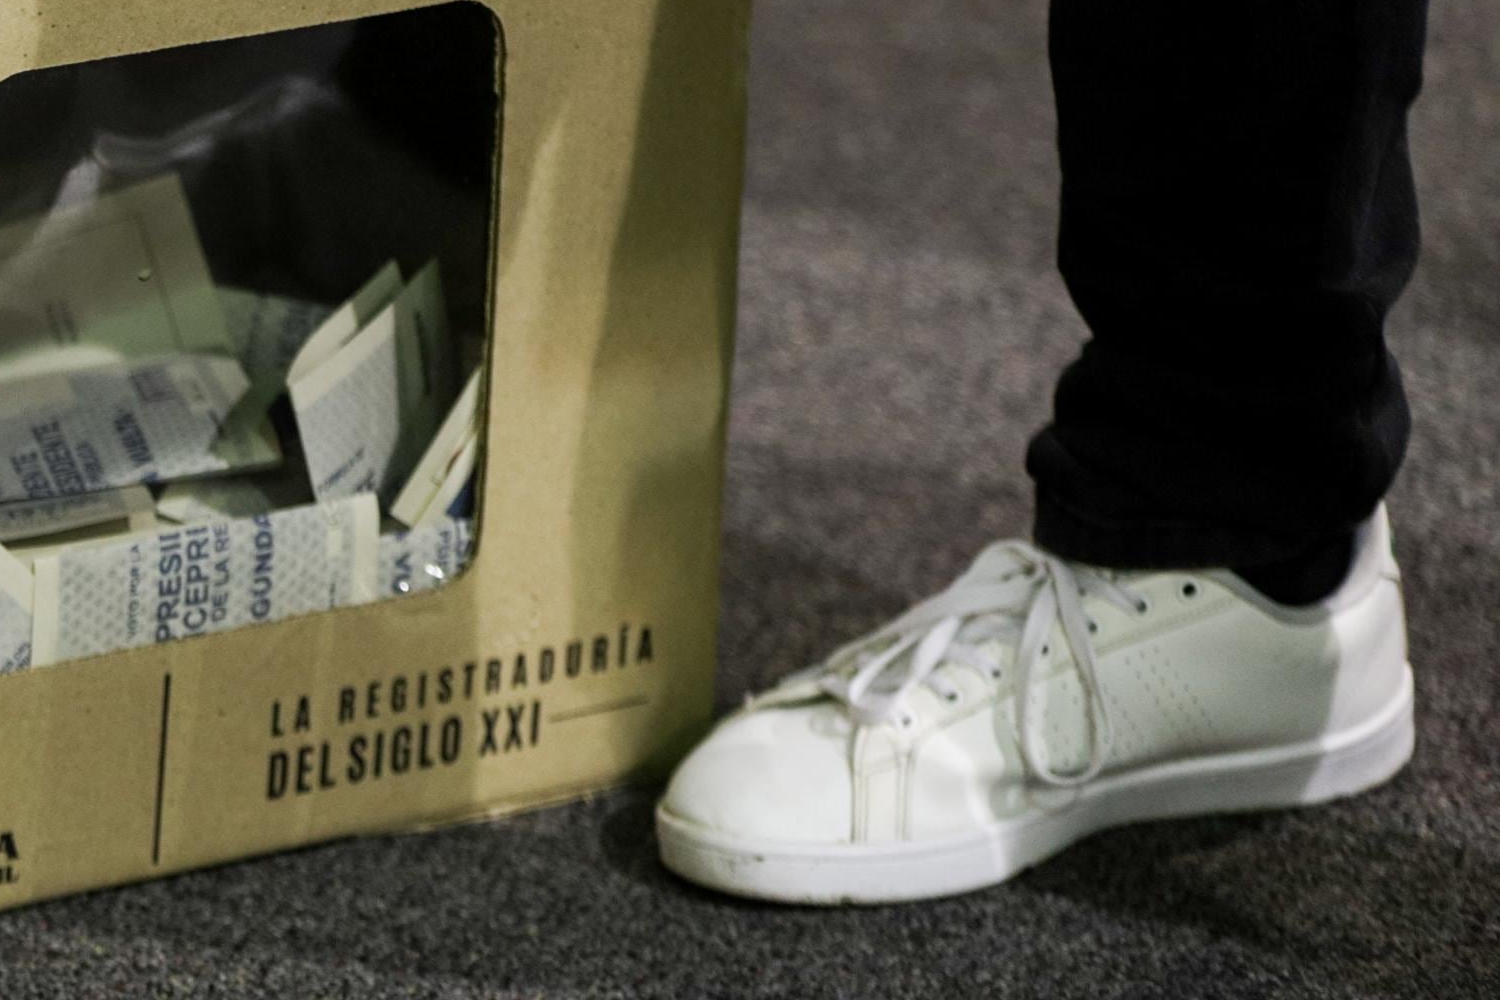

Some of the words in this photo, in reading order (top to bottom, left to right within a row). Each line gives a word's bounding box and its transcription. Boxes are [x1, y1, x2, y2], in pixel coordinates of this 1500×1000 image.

[214, 558, 231, 587] LA
[211, 592, 229, 622] DE
[270, 696, 312, 738] LA
[338, 623, 655, 726] REGISTRADURÍA
[266, 739, 336, 801] DEL
[345, 715, 464, 785] SIGLO
[477, 699, 543, 758] XXI
